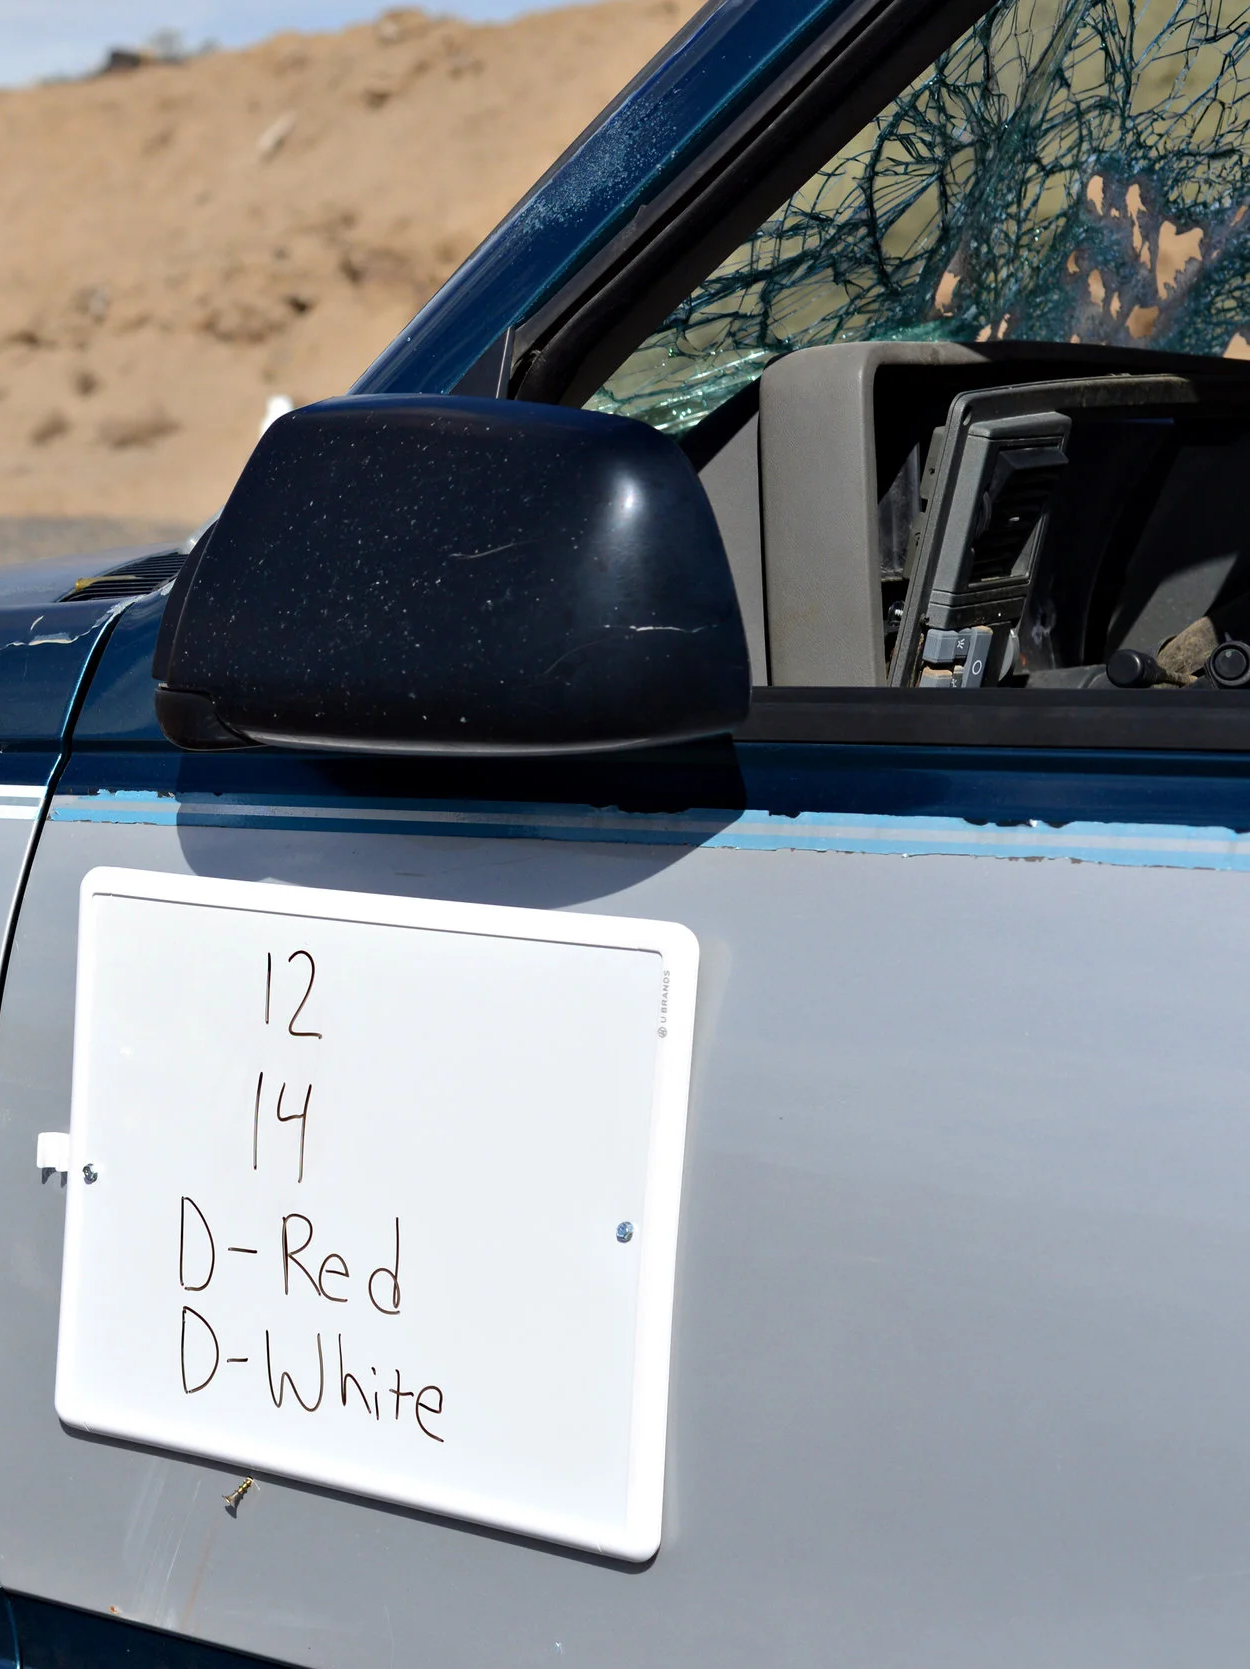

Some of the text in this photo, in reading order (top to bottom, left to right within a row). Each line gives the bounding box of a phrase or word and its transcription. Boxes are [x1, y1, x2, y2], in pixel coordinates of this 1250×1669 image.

[264, 949, 323, 1040] 12
[661, 970, 670, 1013] BRANDS
[253, 1070, 313, 1184] 14
